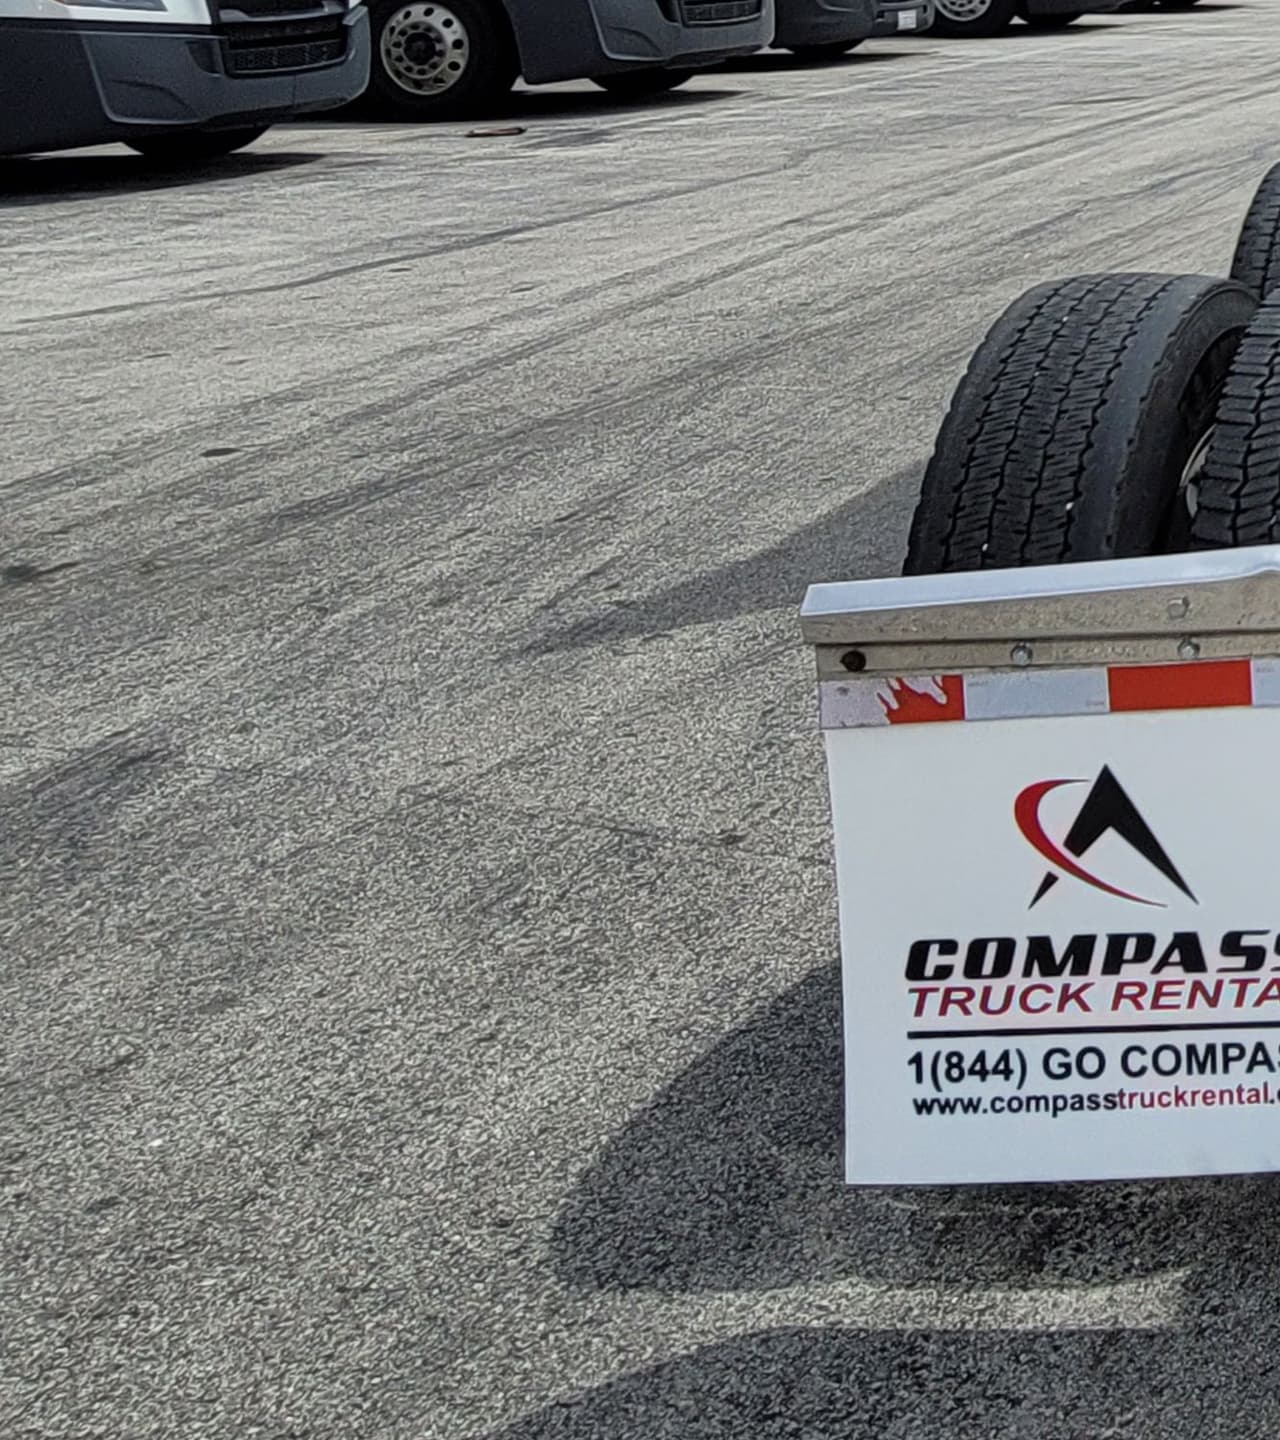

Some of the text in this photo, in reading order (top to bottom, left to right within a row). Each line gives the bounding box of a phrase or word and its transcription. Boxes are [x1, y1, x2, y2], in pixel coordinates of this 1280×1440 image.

[908, 981, 1095, 1018] TRUCK
[907, 1047, 1028, 1093] 1(844)
[1041, 1045, 1107, 1081] GO
